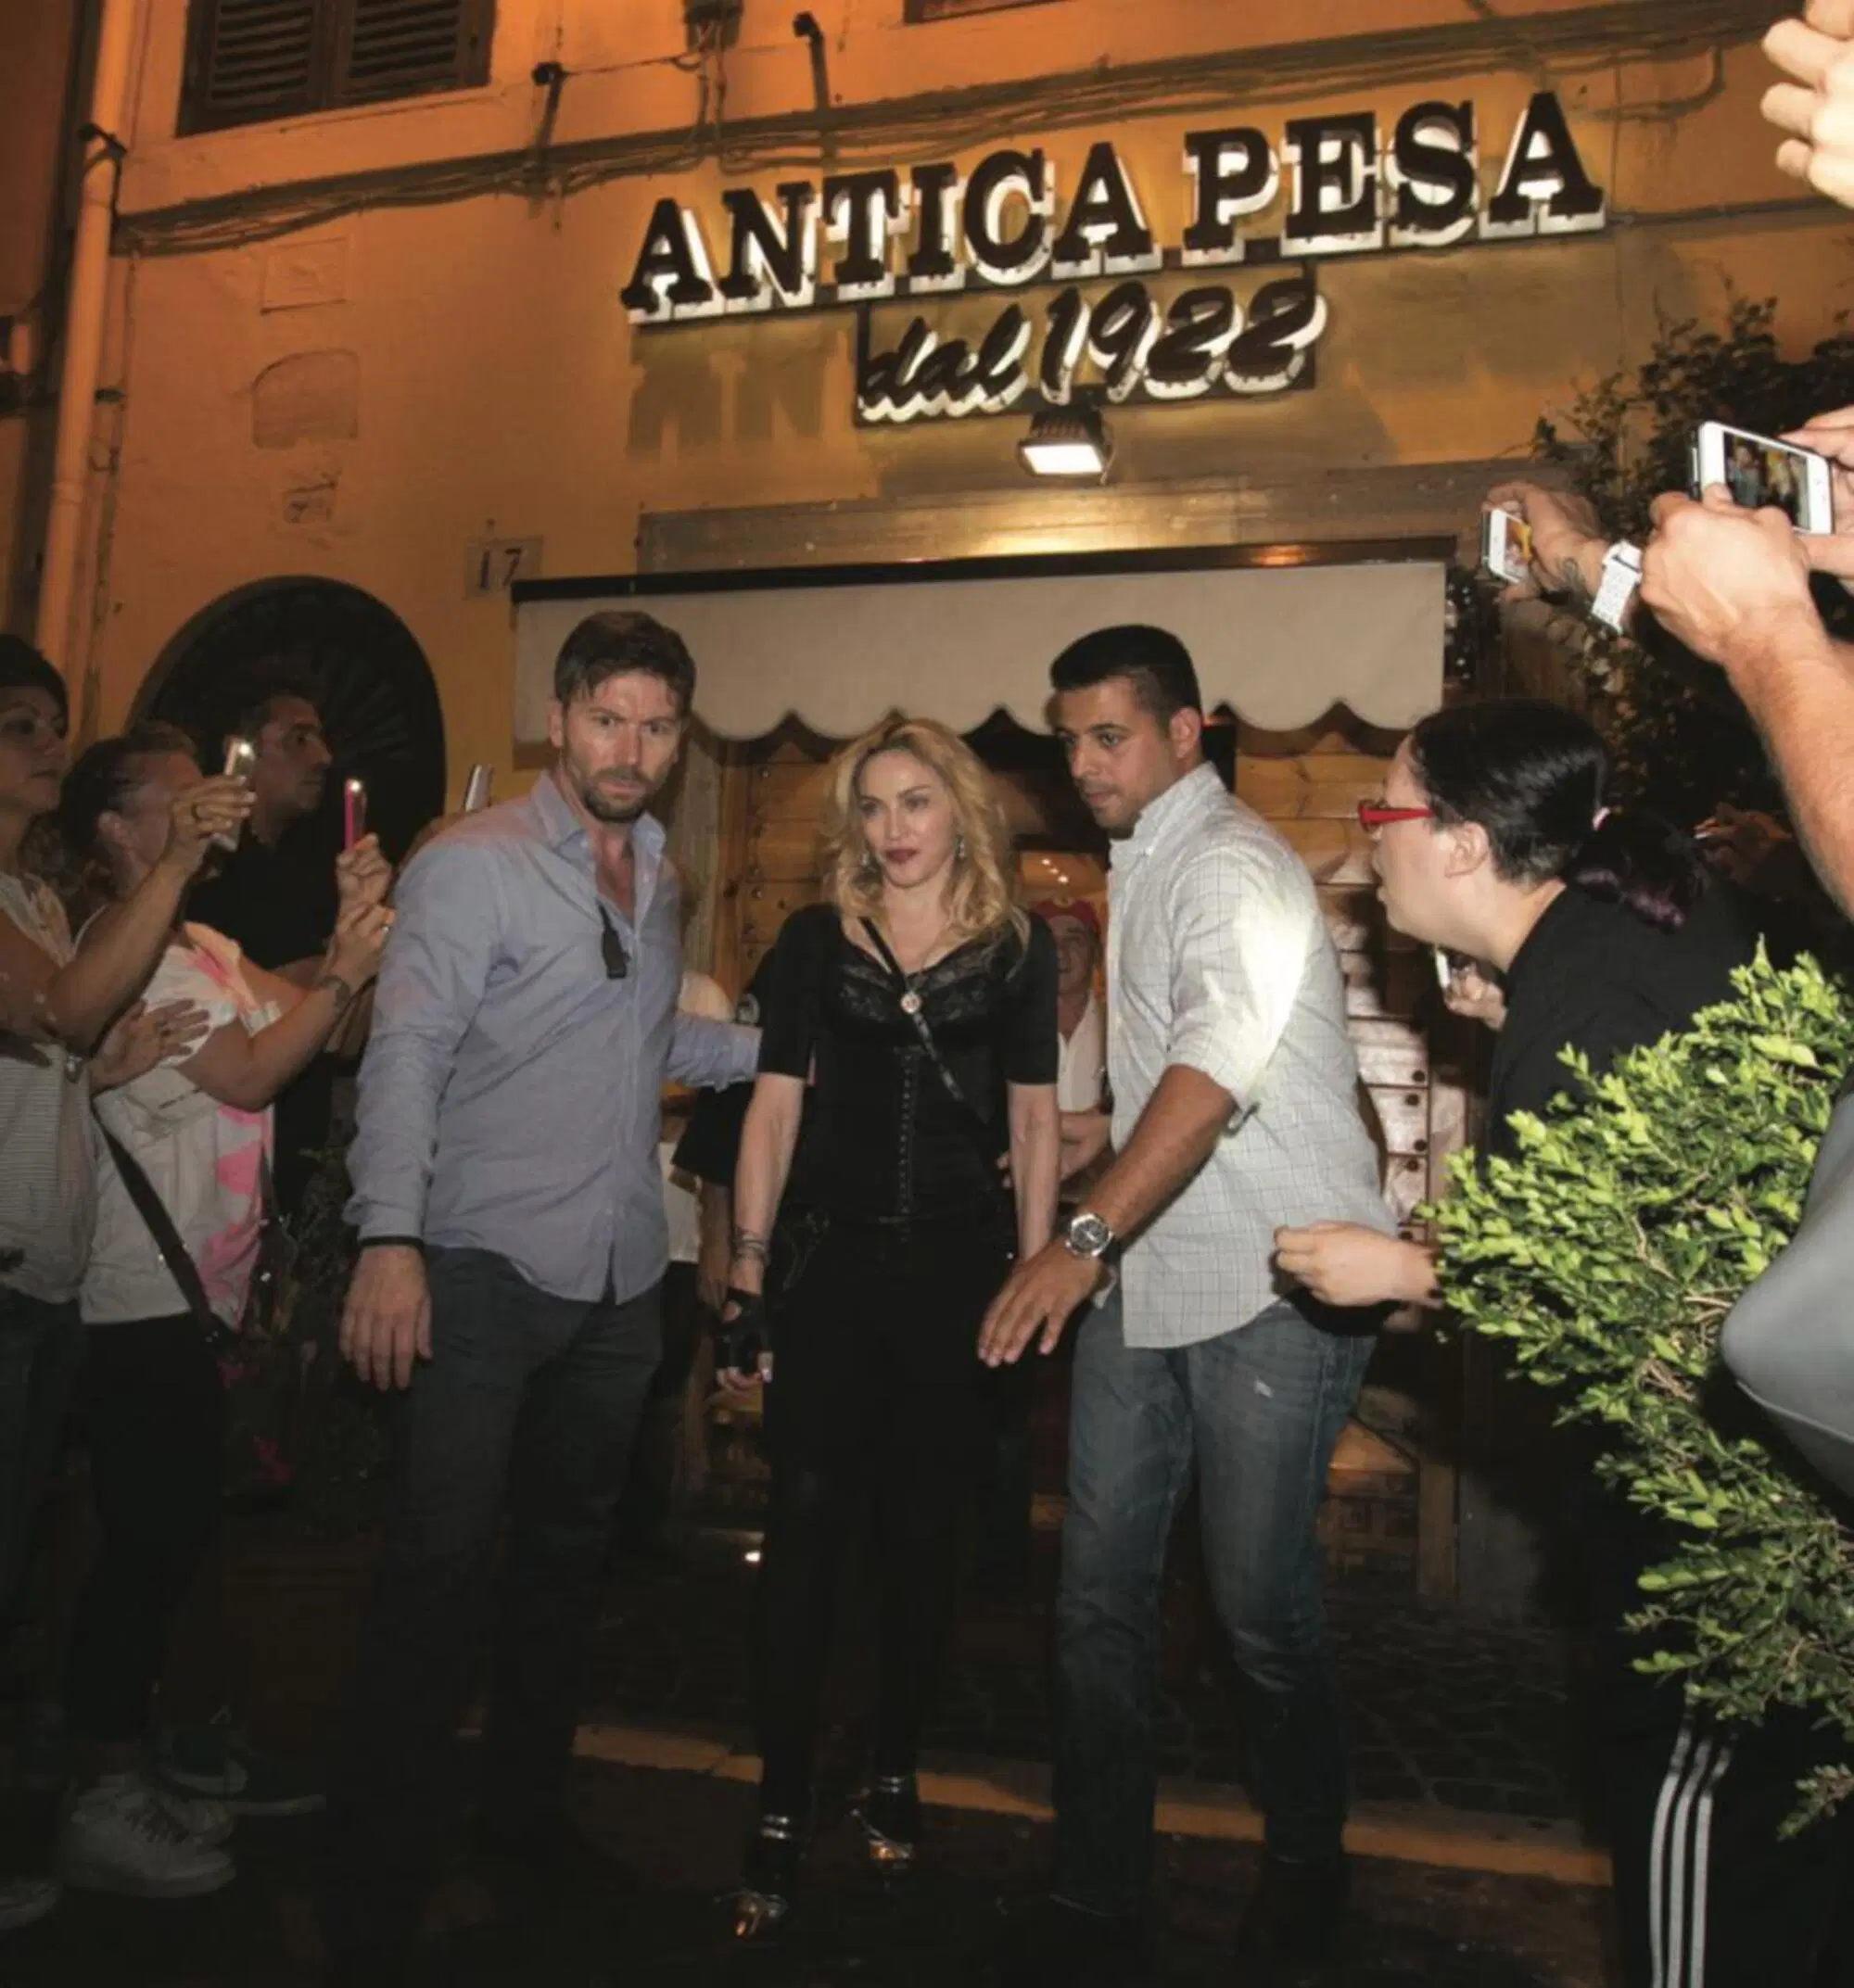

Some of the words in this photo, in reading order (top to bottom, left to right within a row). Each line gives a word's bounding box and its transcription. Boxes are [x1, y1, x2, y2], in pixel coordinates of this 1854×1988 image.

[622, 142, 1161, 323] ANTICA
[1182, 91, 1606, 266] PESA
[857, 302, 1032, 422] dal
[1039, 280, 1327, 406] 1922
[478, 547, 524, 590] 17
